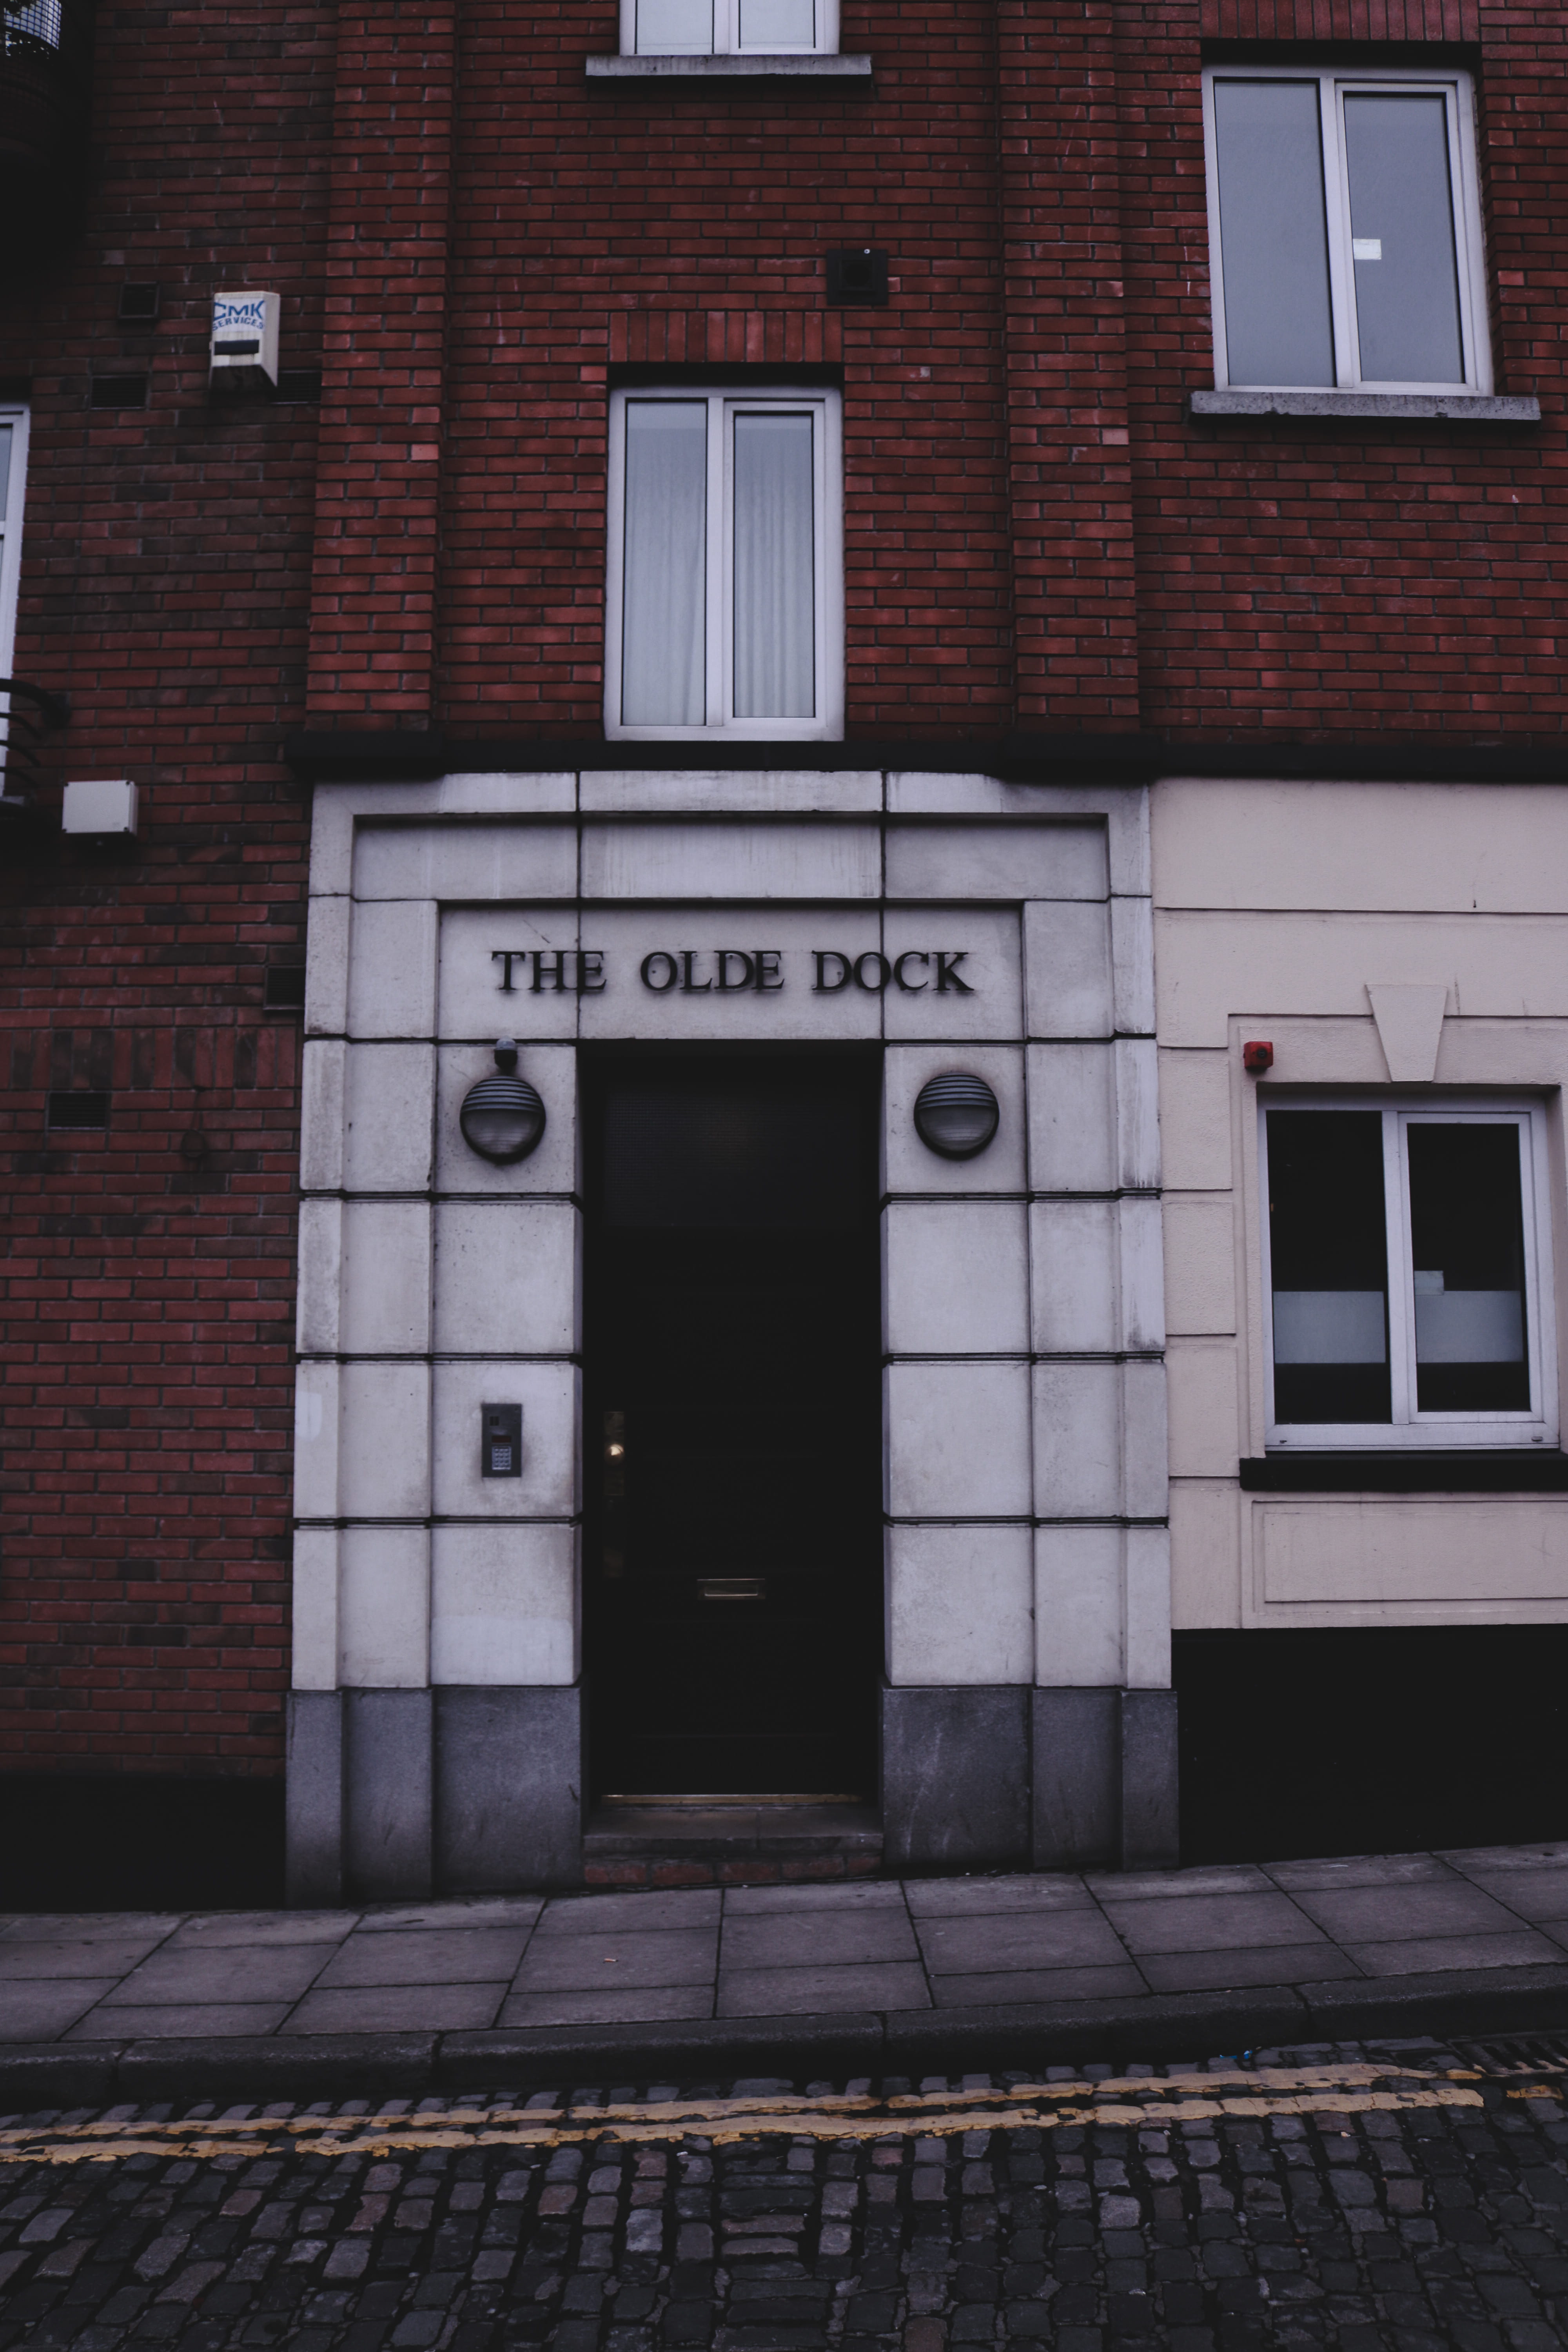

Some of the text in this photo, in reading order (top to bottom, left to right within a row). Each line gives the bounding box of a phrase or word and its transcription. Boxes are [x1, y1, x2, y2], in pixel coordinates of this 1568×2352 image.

[214, 300, 264, 320] CMK
[212, 317, 264, 331] SERVICES
[492, 951, 973, 991] THE OLDE DOCK
